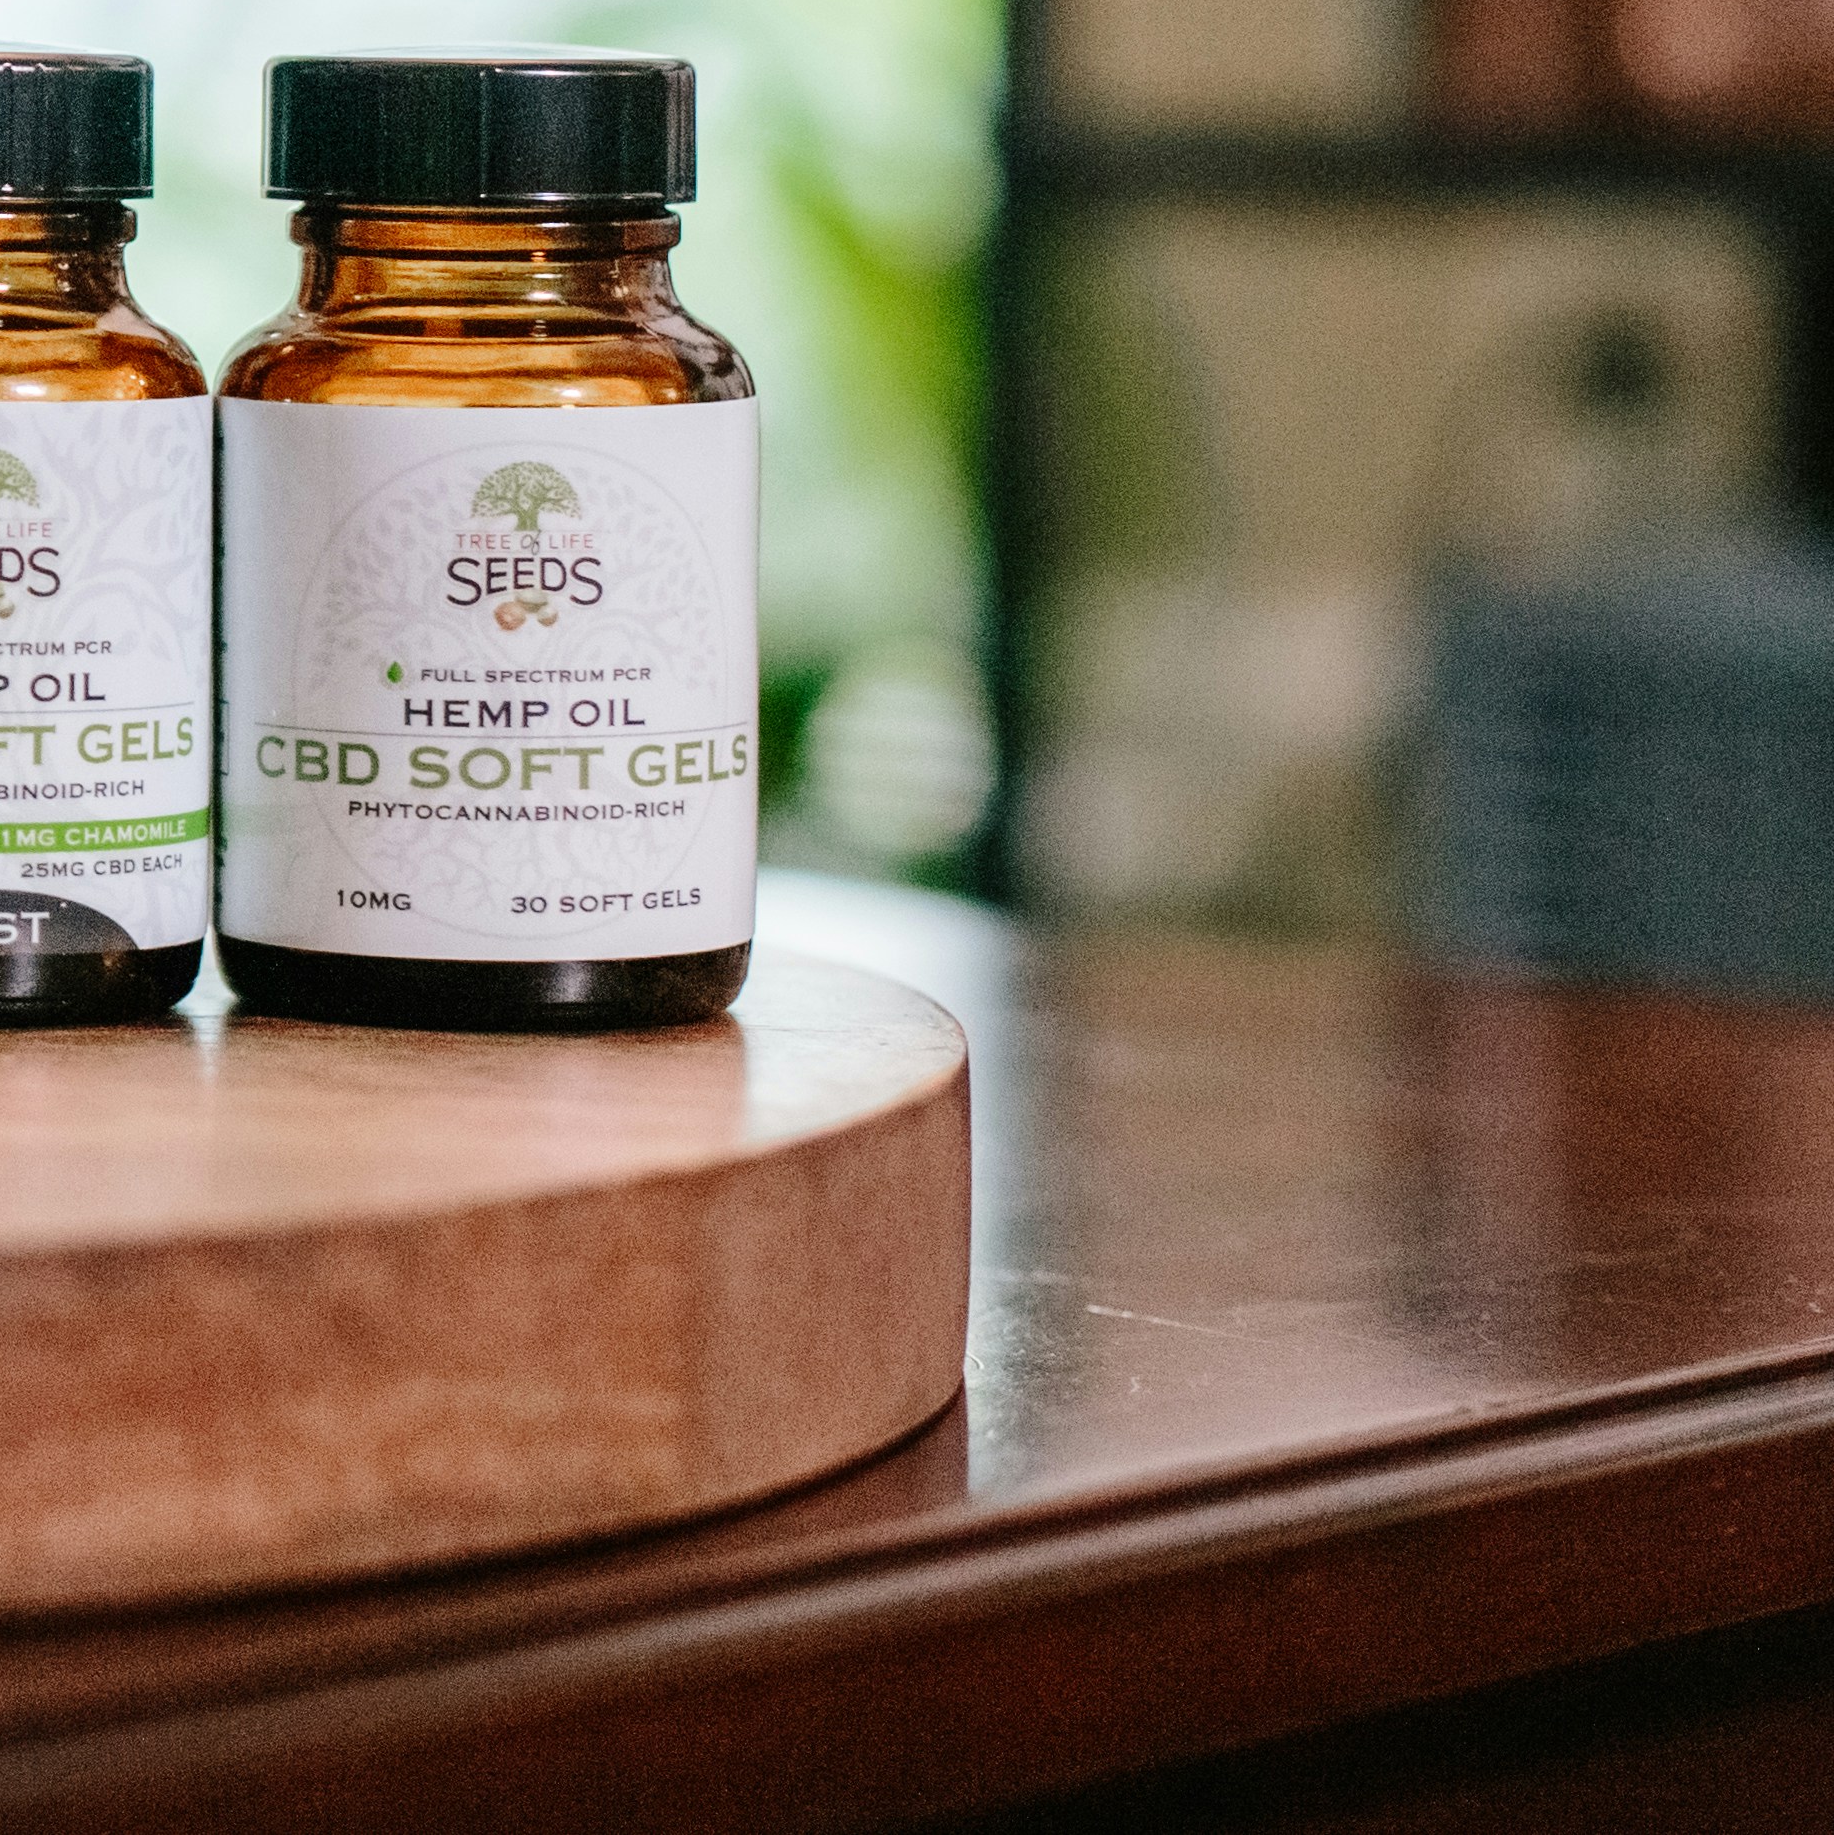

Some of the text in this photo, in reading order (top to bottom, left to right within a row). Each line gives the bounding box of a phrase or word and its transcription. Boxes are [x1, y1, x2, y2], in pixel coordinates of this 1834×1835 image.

[7, 521, 53, 538] LIFE
[456, 533, 511, 550] TREE
[549, 533, 594, 550] LIFE
[447, 557, 603, 606] SEEDS
[73, 640, 112, 655] PCR
[31, 672, 105, 701] OIL
[420, 667, 651, 683] FULL SPECTRUM PCR
[404, 698, 645, 728] HEMP OIL
[77, 717, 194, 763] GELS
[256, 734, 748, 791] CBD SOFT GELS
[348, 800, 685, 822] PHYTOCANNABINOID-RICH
[2, 829, 55, 848] 1MG
[65, 819, 186, 844] CHAMOMILE
[21, 854, 183, 878] 25MG CBD EACH
[337, 890, 412, 911] 10MG
[511, 888, 702, 914] 30 SOFT GELS
